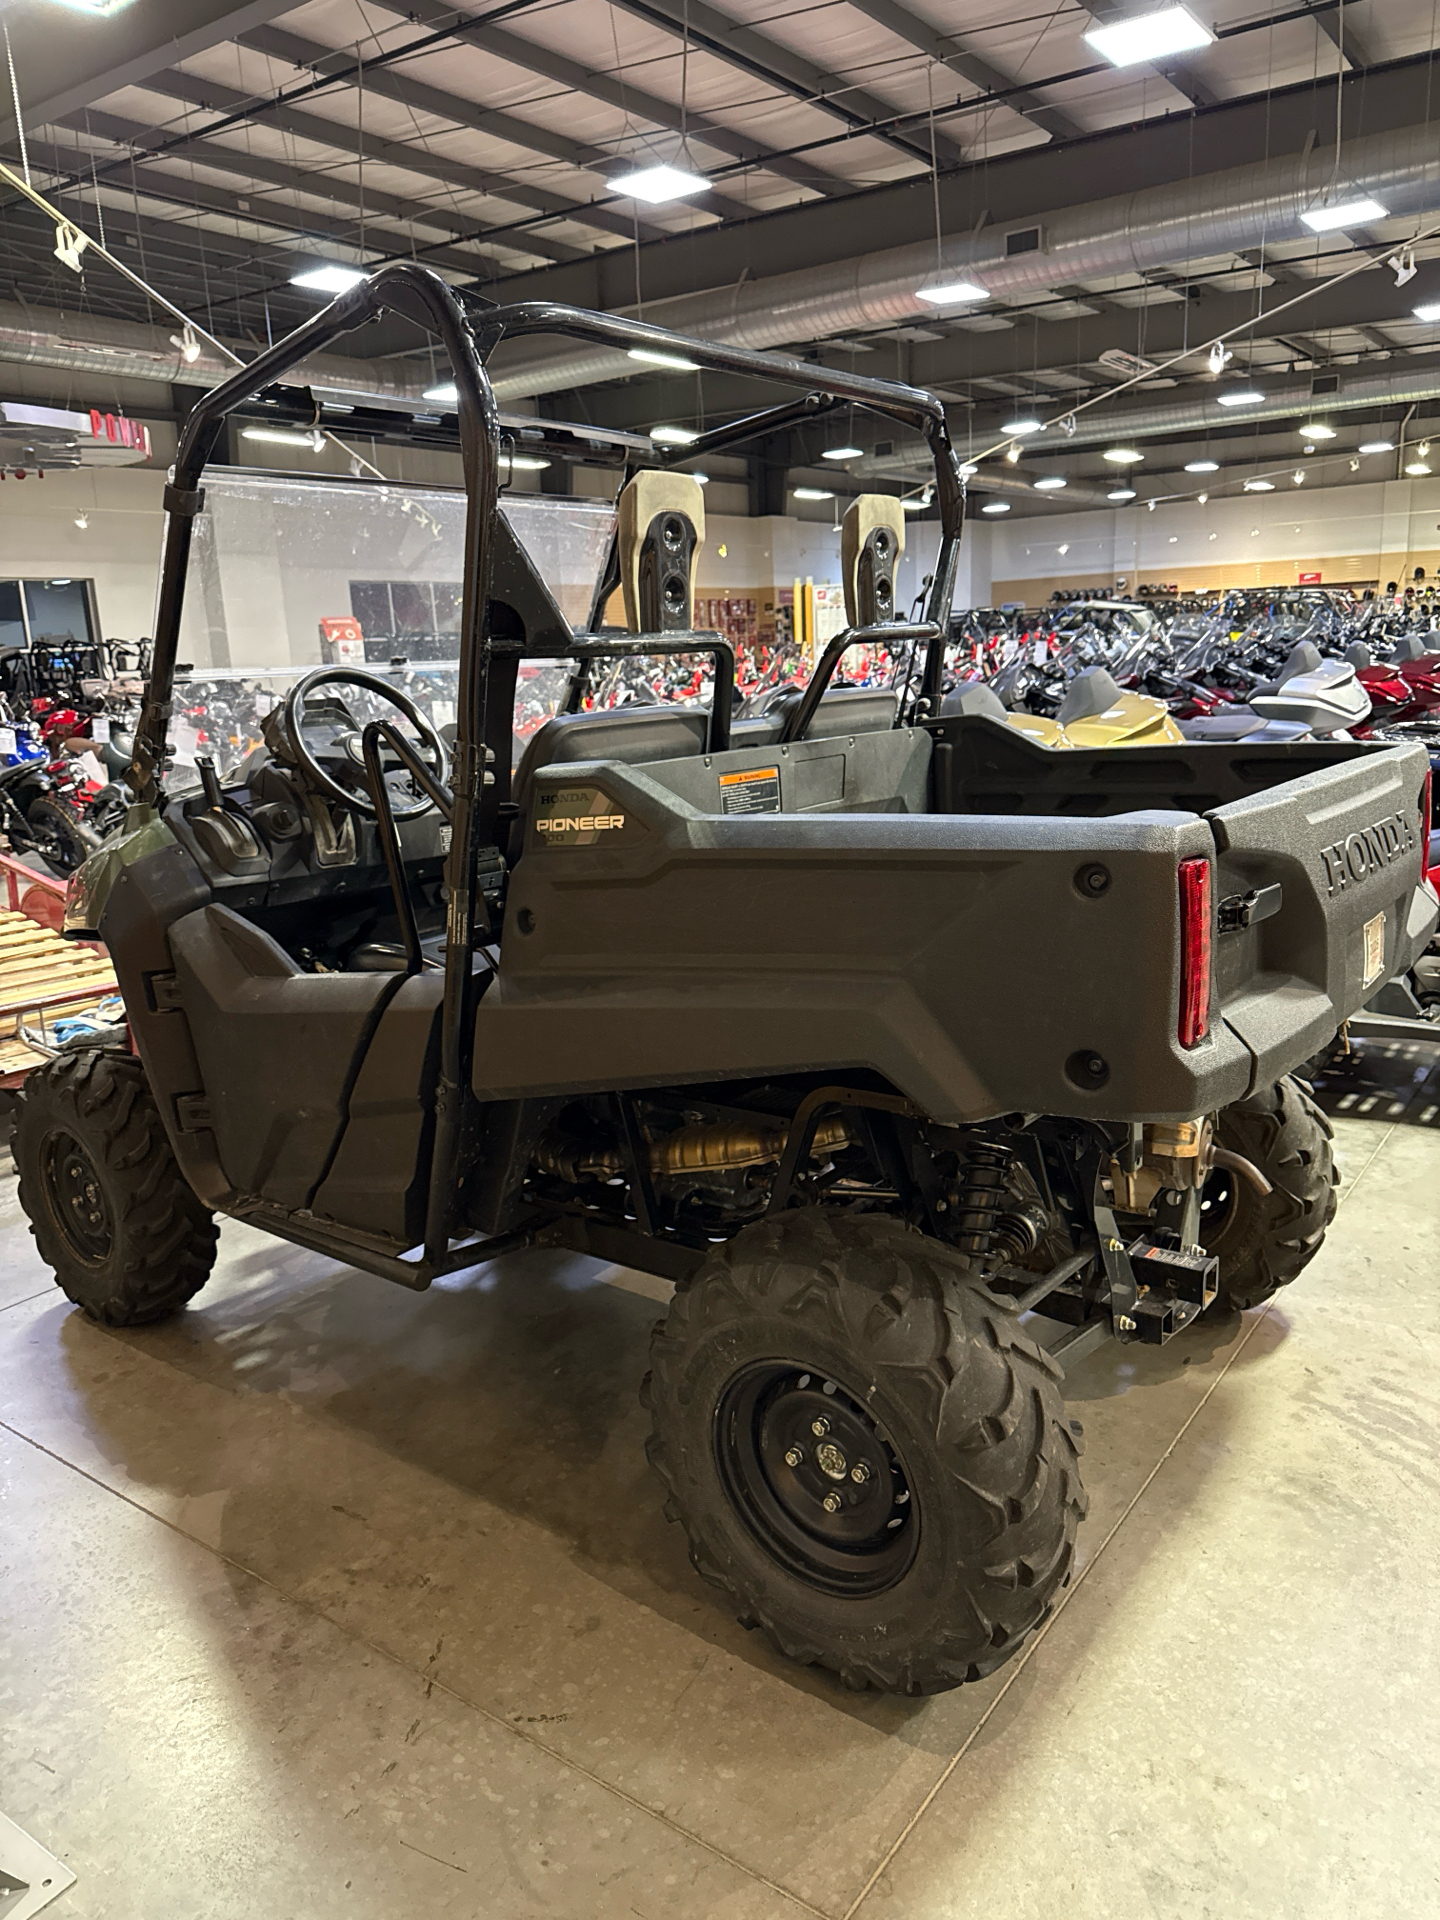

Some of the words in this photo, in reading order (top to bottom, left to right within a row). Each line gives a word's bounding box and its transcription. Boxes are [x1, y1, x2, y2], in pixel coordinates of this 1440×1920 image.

[541, 793, 590, 804] HONDA
[536, 815, 625, 832] PIONEER
[541, 834, 565, 842] 00
[1320, 809, 1416, 897] HONDA
